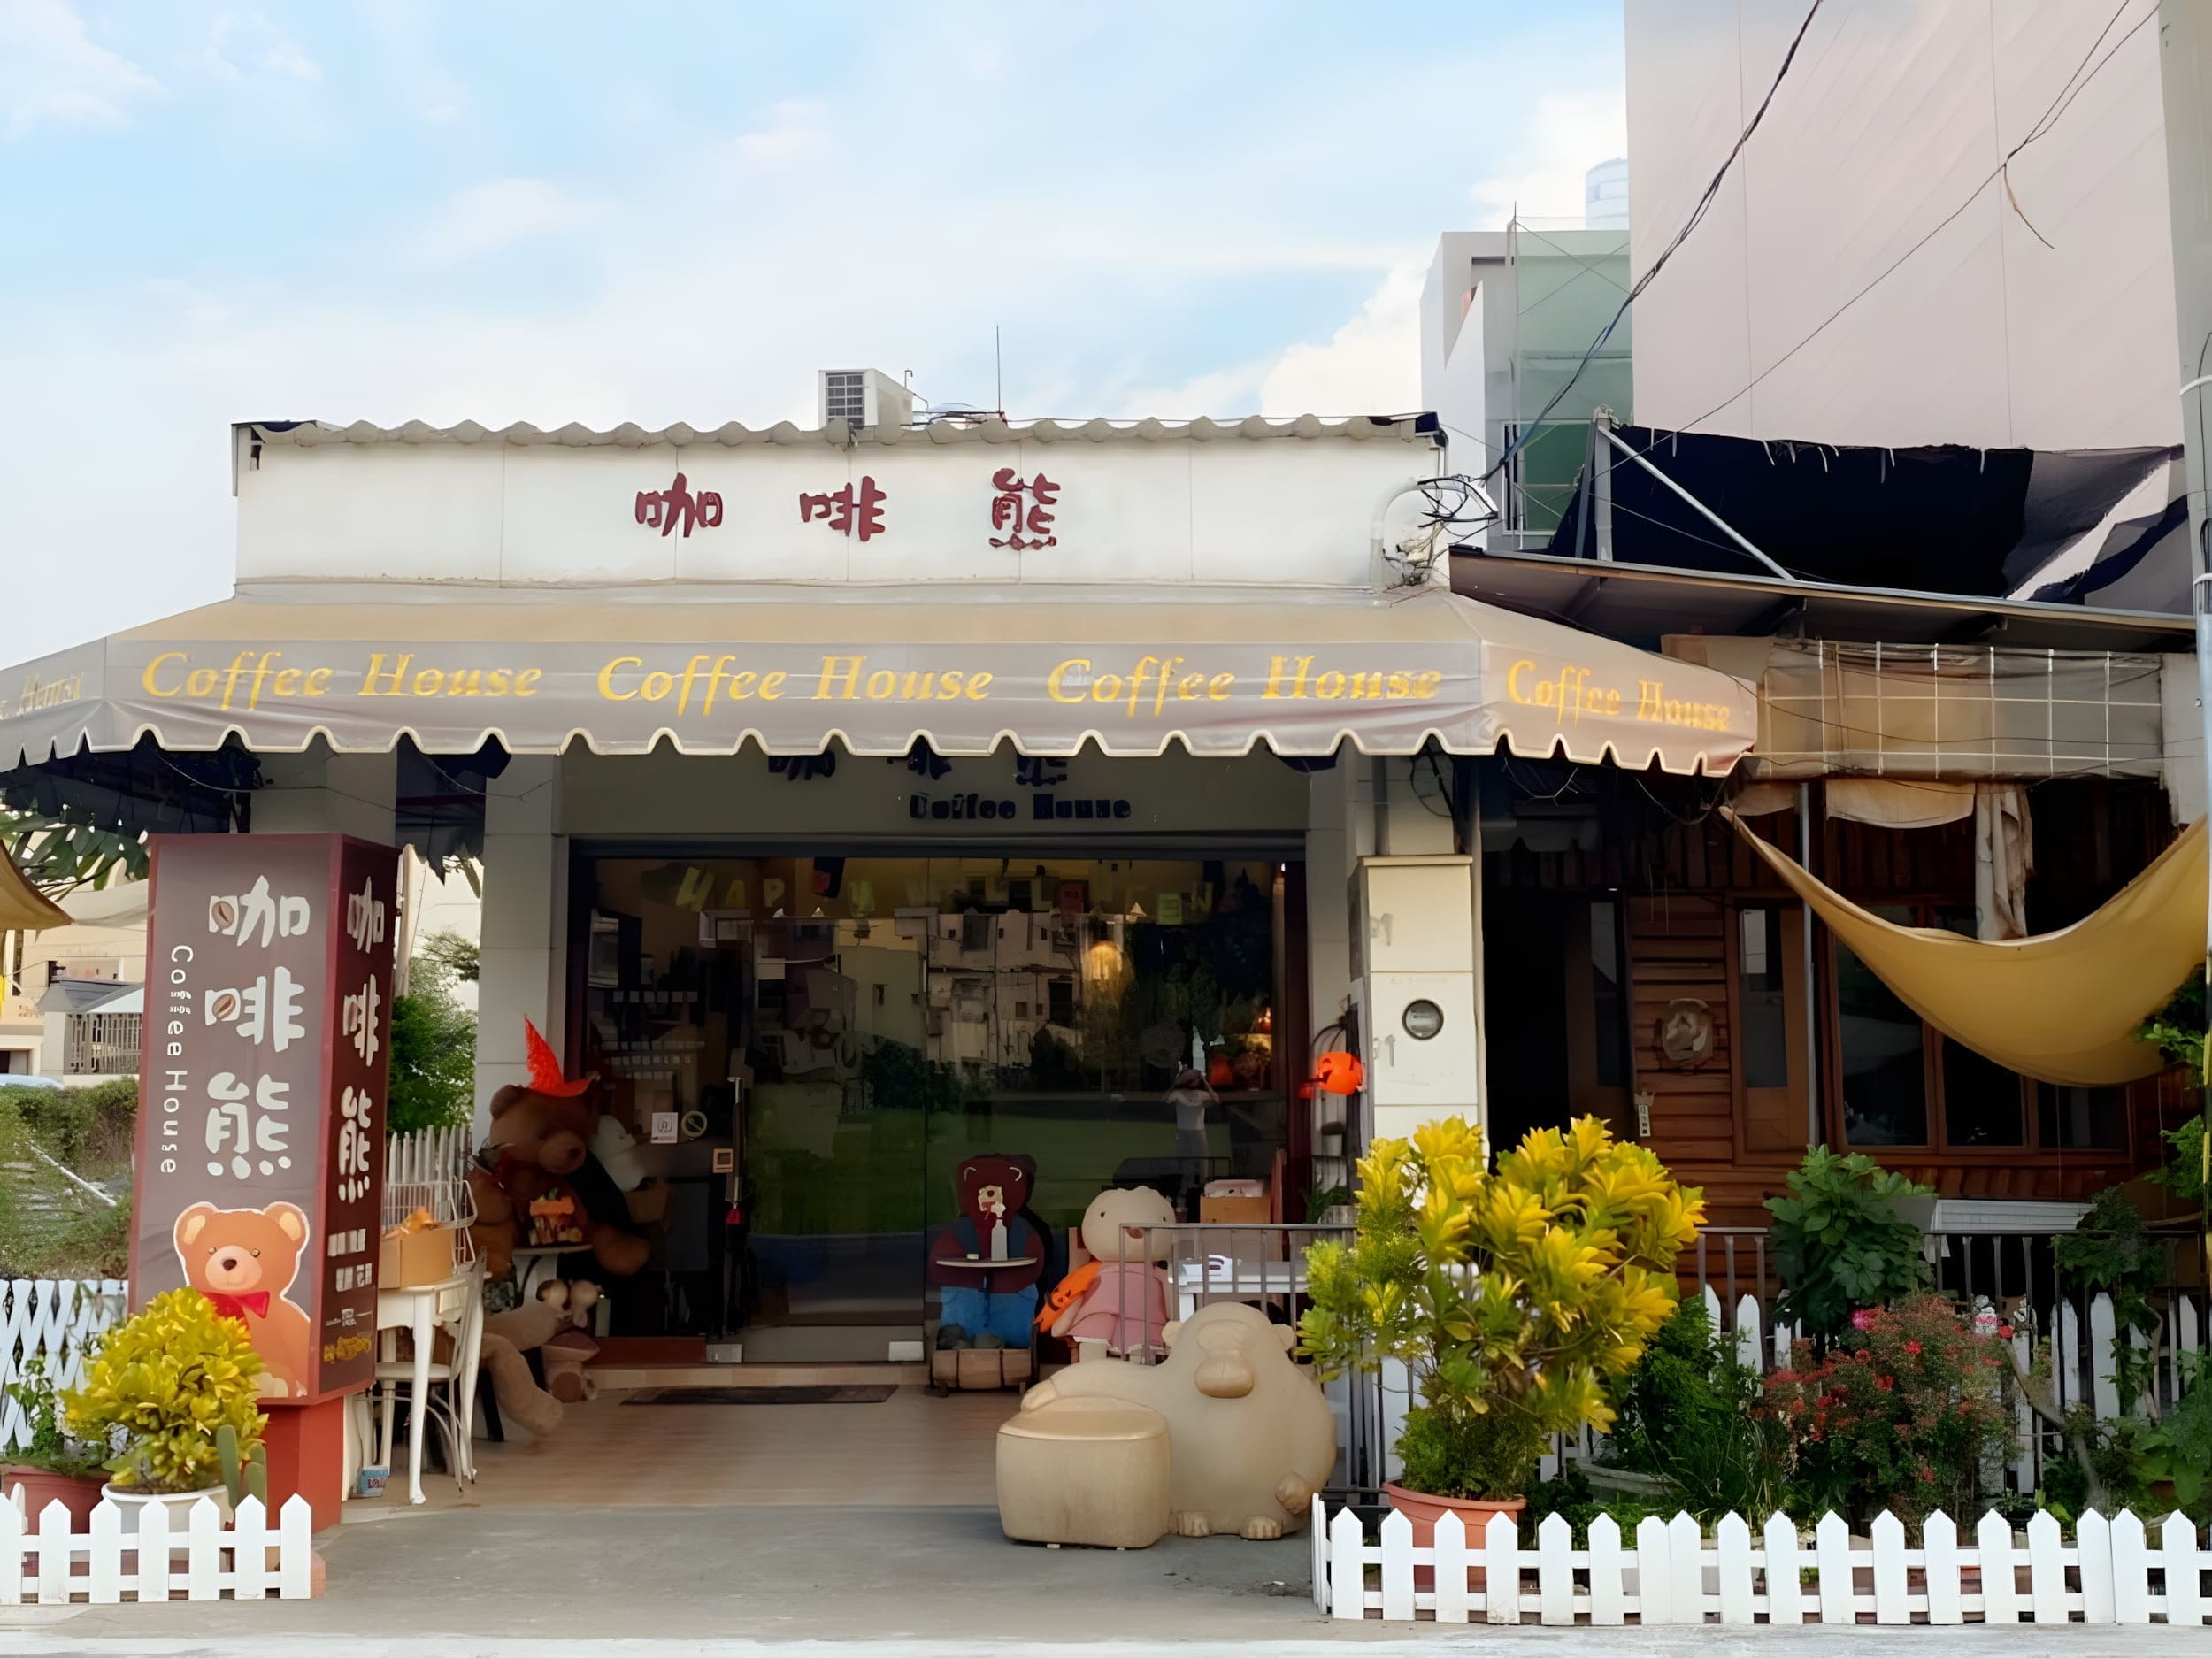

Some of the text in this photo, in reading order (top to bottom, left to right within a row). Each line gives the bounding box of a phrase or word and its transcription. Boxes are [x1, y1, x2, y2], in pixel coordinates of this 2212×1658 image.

[634, 467, 1061, 551] 咖啡熊
[142, 651, 334, 710] Coffee
[358, 653, 542, 697] House
[597, 654, 994, 717] Coffee House
[1048, 656, 1442, 718] Coffee House
[1507, 659, 1621, 728] Coffee
[204, 874, 311, 1180] 咖啡熊
[338, 875, 385, 1204] 咖啡熊
